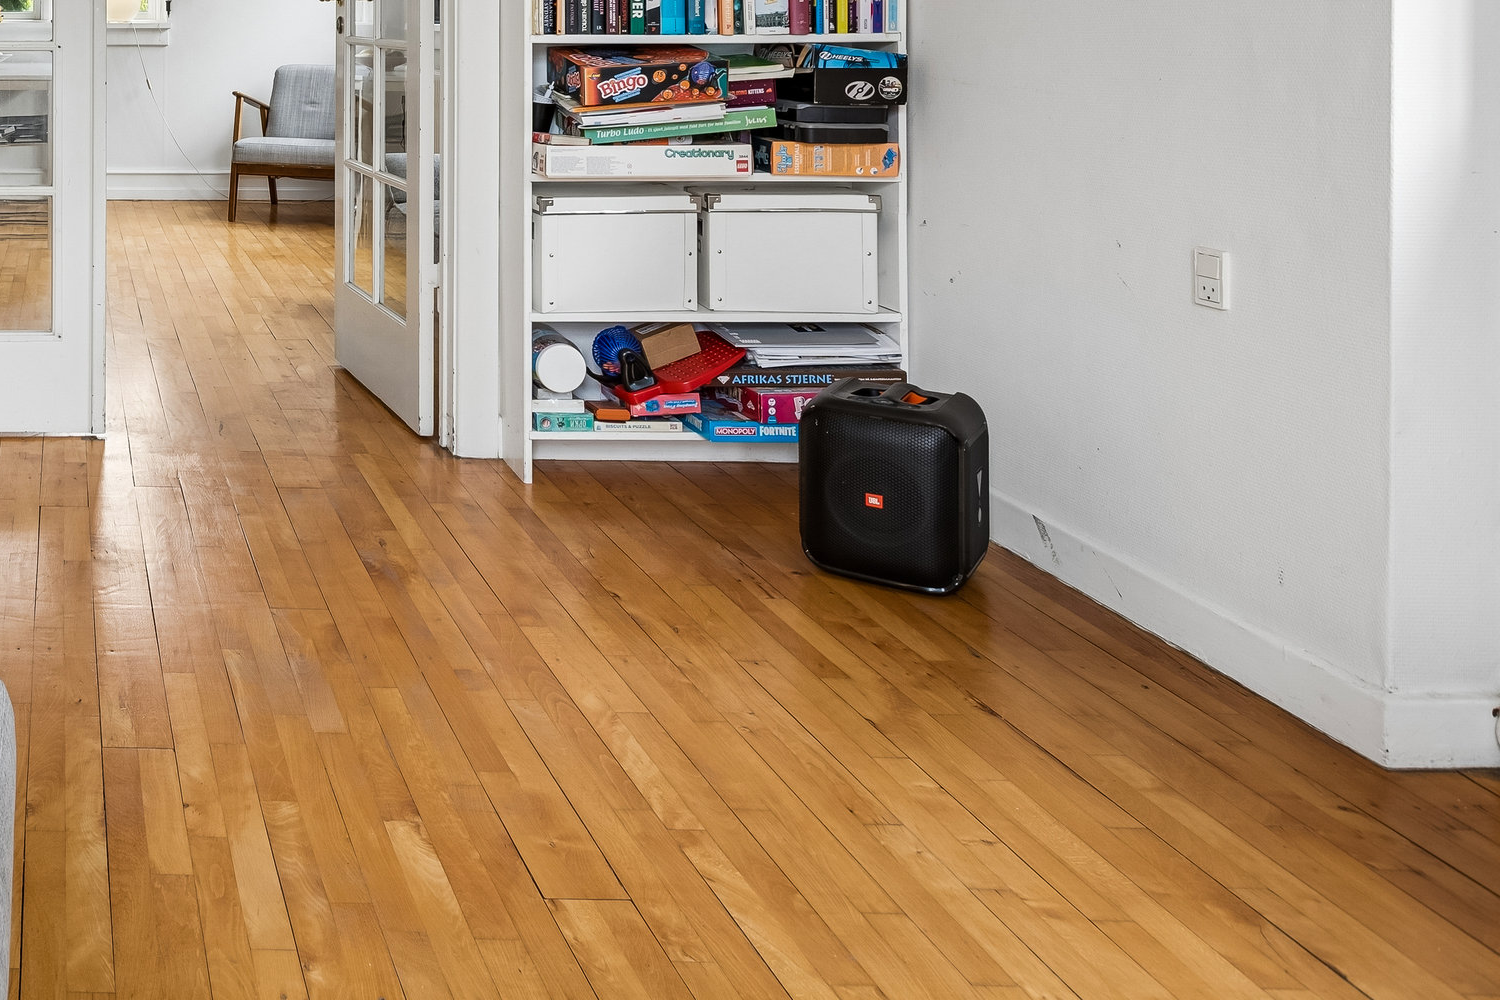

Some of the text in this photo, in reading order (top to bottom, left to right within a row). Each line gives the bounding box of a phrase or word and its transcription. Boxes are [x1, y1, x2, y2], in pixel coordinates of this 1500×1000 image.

[831, 55, 863, 63] HEELYS
[598, 74, 647, 99] Bingo
[596, 127, 644, 139] Turbo Ludo
[665, 148, 734, 160] Creationary
[732, 374, 832, 384] AFRIKAS STJERNE
[715, 426, 797, 436] MONOPOLY FORTNITE
[868, 497, 880, 505] JBL
